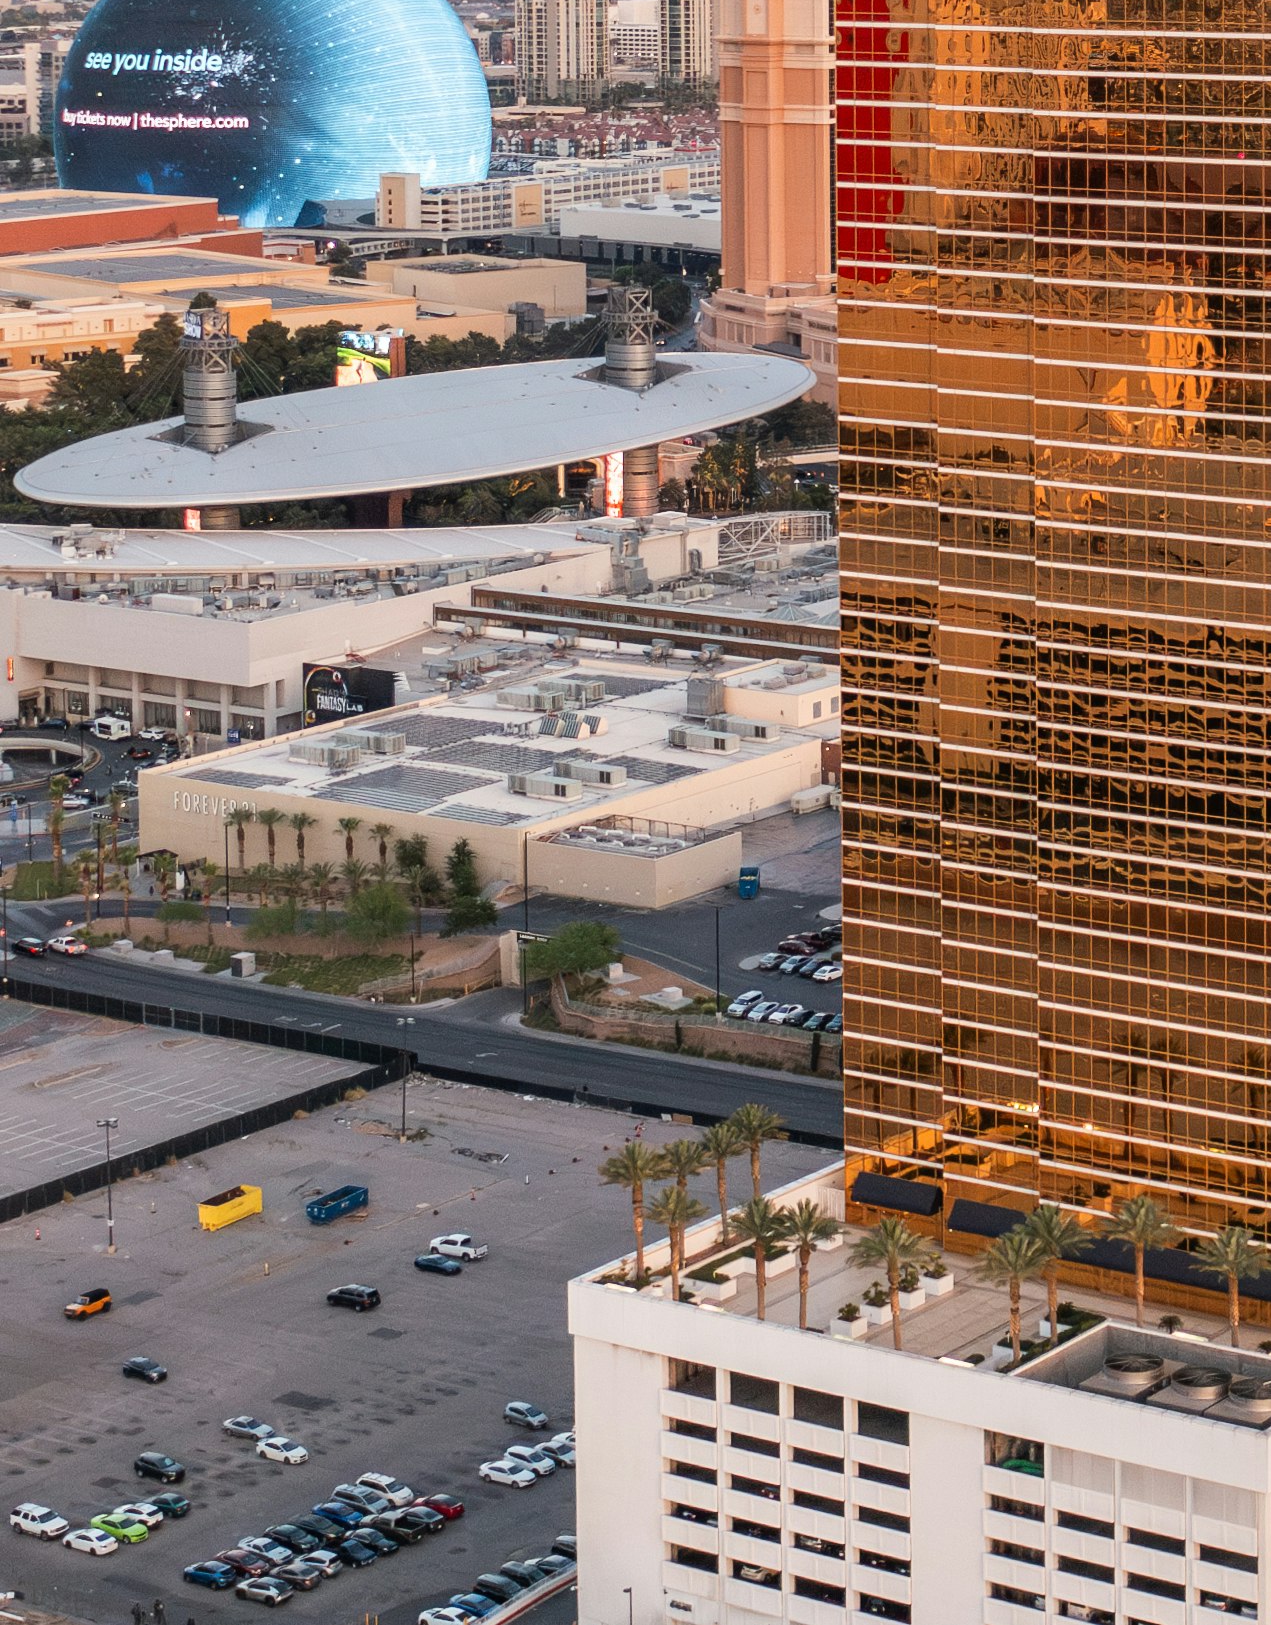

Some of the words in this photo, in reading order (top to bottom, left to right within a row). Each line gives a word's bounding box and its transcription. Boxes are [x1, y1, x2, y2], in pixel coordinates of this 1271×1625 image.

[85, 51, 112, 70] see
[114, 51, 149, 76] you
[152, 48, 223, 72] inside
[106, 116, 131, 127] now
[140, 112, 249, 131] thesphere.com
[316, 694, 346, 713] FANTASY
[346, 703, 363, 712] LAB
